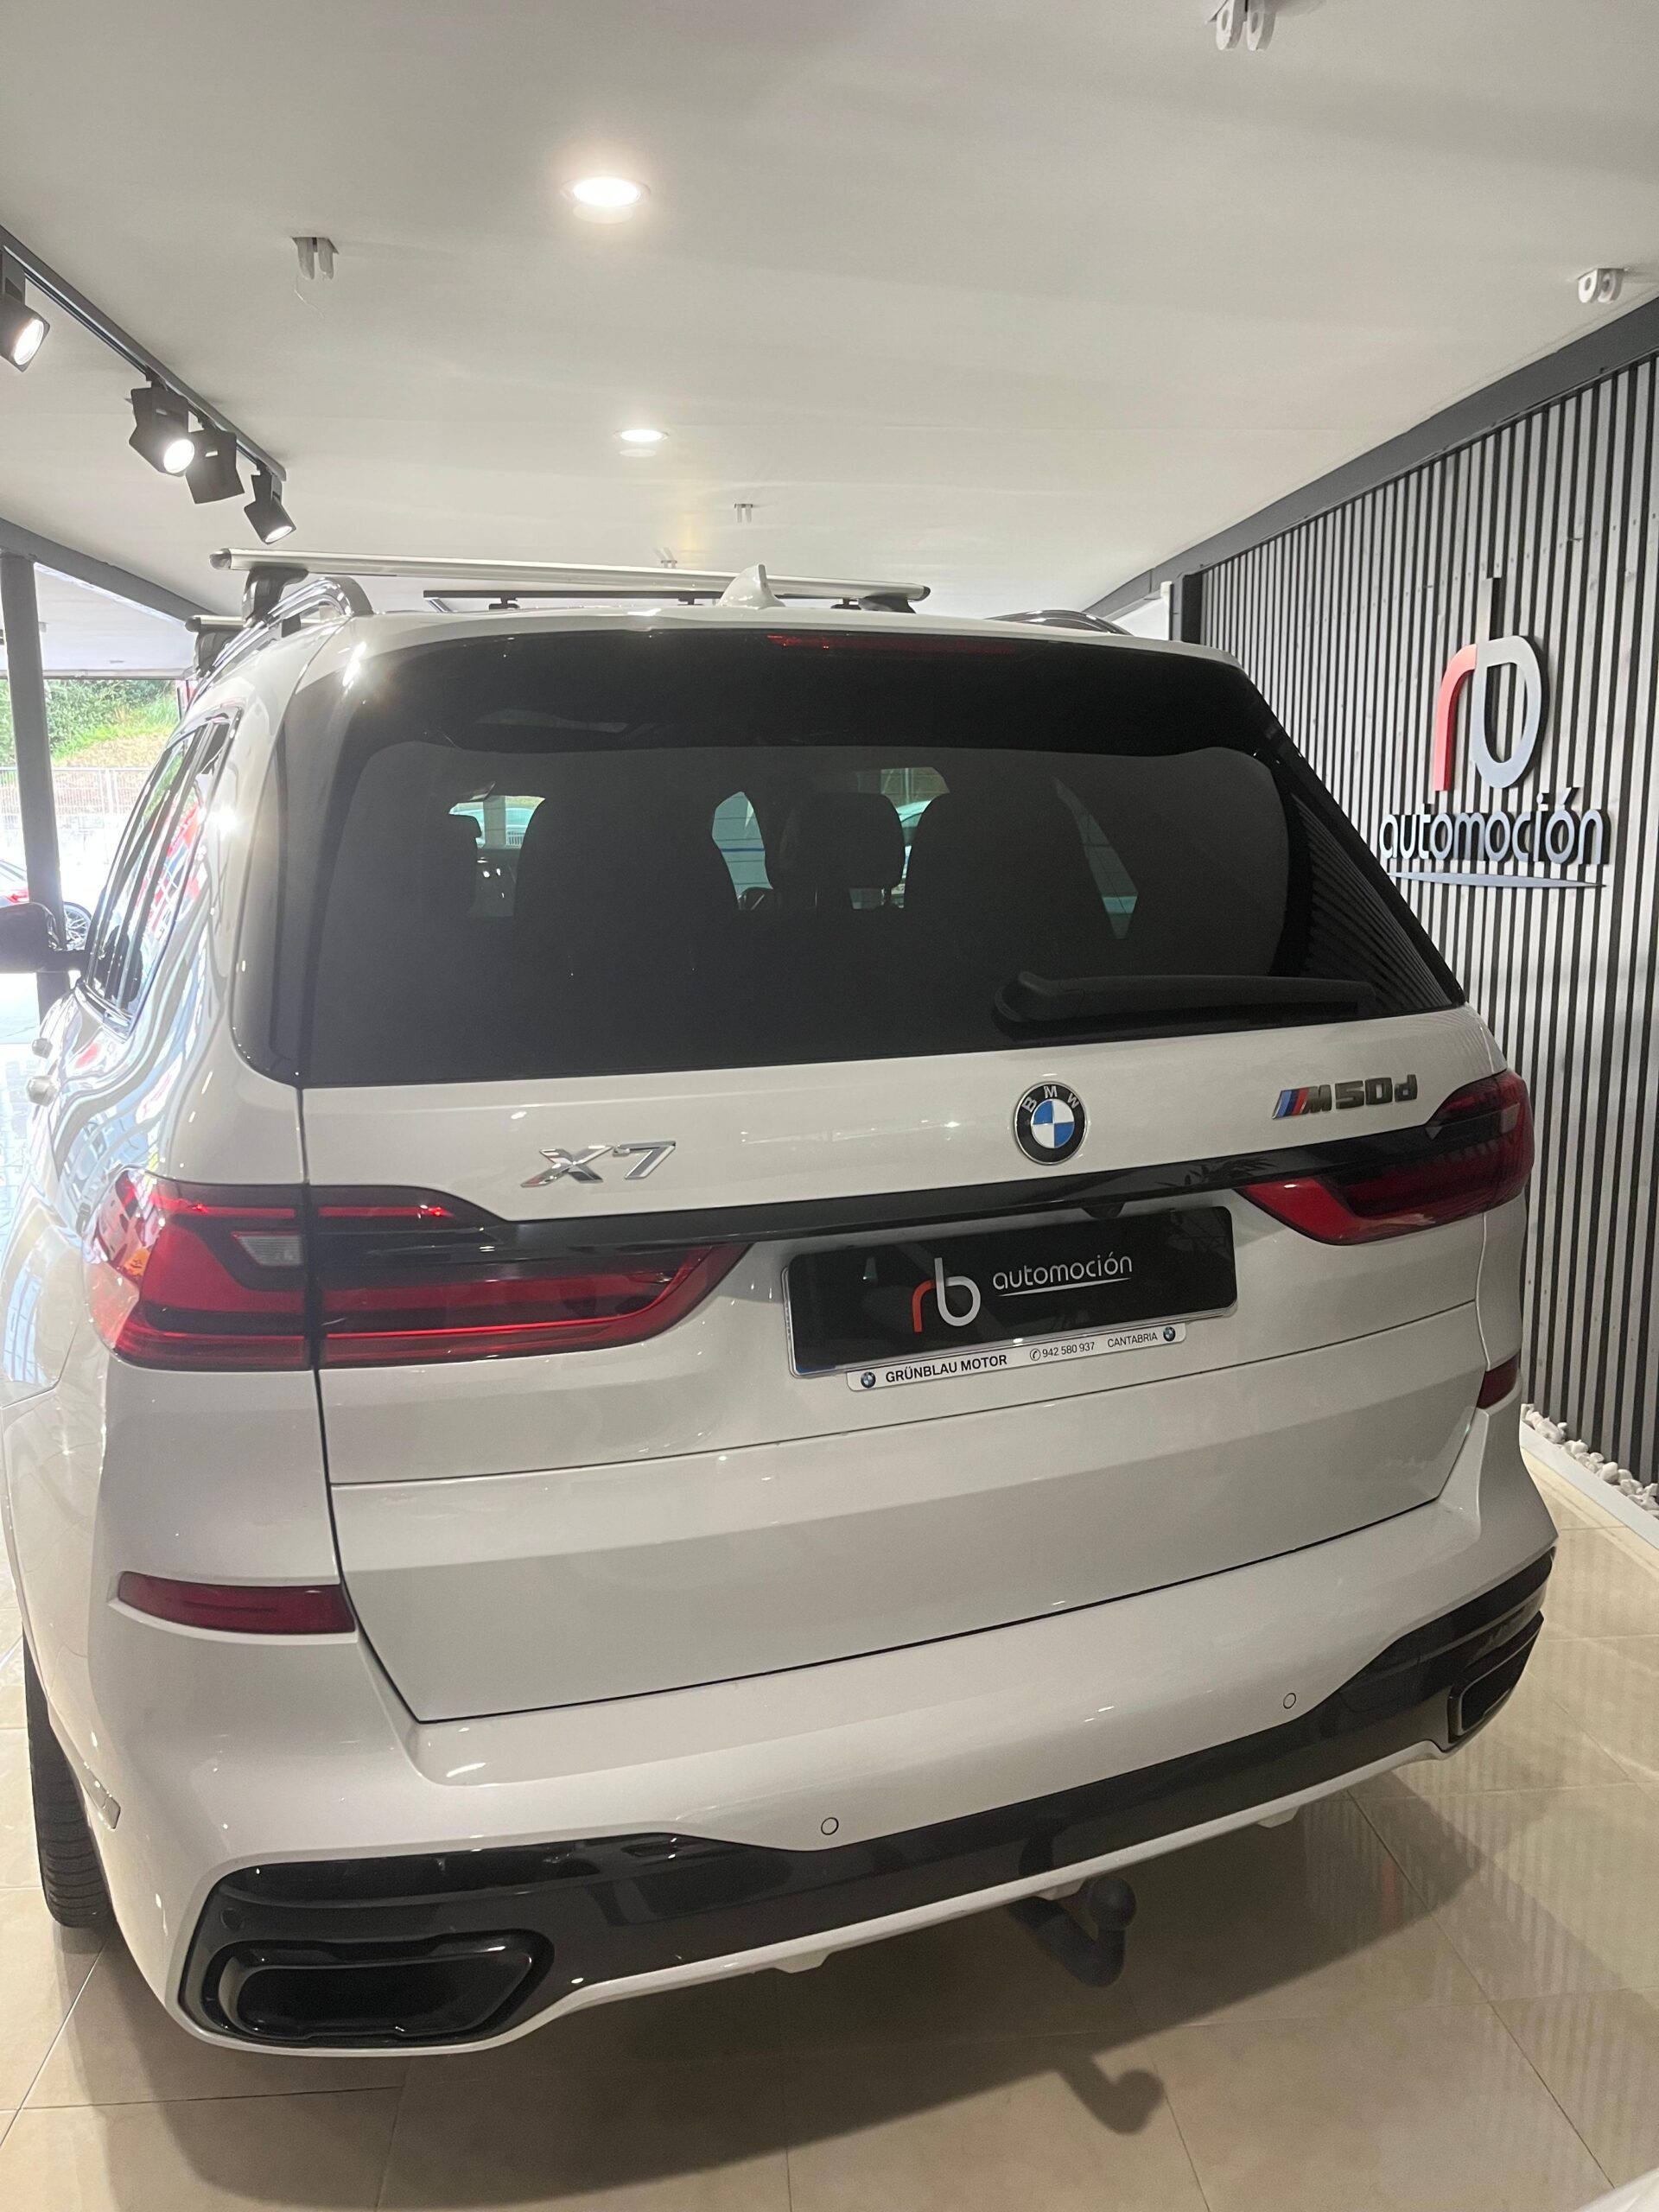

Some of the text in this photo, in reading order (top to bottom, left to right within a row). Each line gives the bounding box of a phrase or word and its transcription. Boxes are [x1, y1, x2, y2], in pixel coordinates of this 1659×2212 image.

[1379, 787, 1605, 865] automoción
[1021, 1085, 1080, 1113] BMW
[1273, 1074, 1418, 1119] M50d
[520, 1141, 676, 1187] X7
[912, 1252, 1133, 1332] rb automoción
[885, 1362, 957, 1382] GRÜNBLAU
[961, 1355, 1007, 1371] MOTOR
[1042, 1346, 1059, 1358] 942
[1061, 1344, 1077, 1356] 580
[1079, 1342, 1095, 1352] 937
[1108, 1332, 1158, 1348] CANTABRIA
